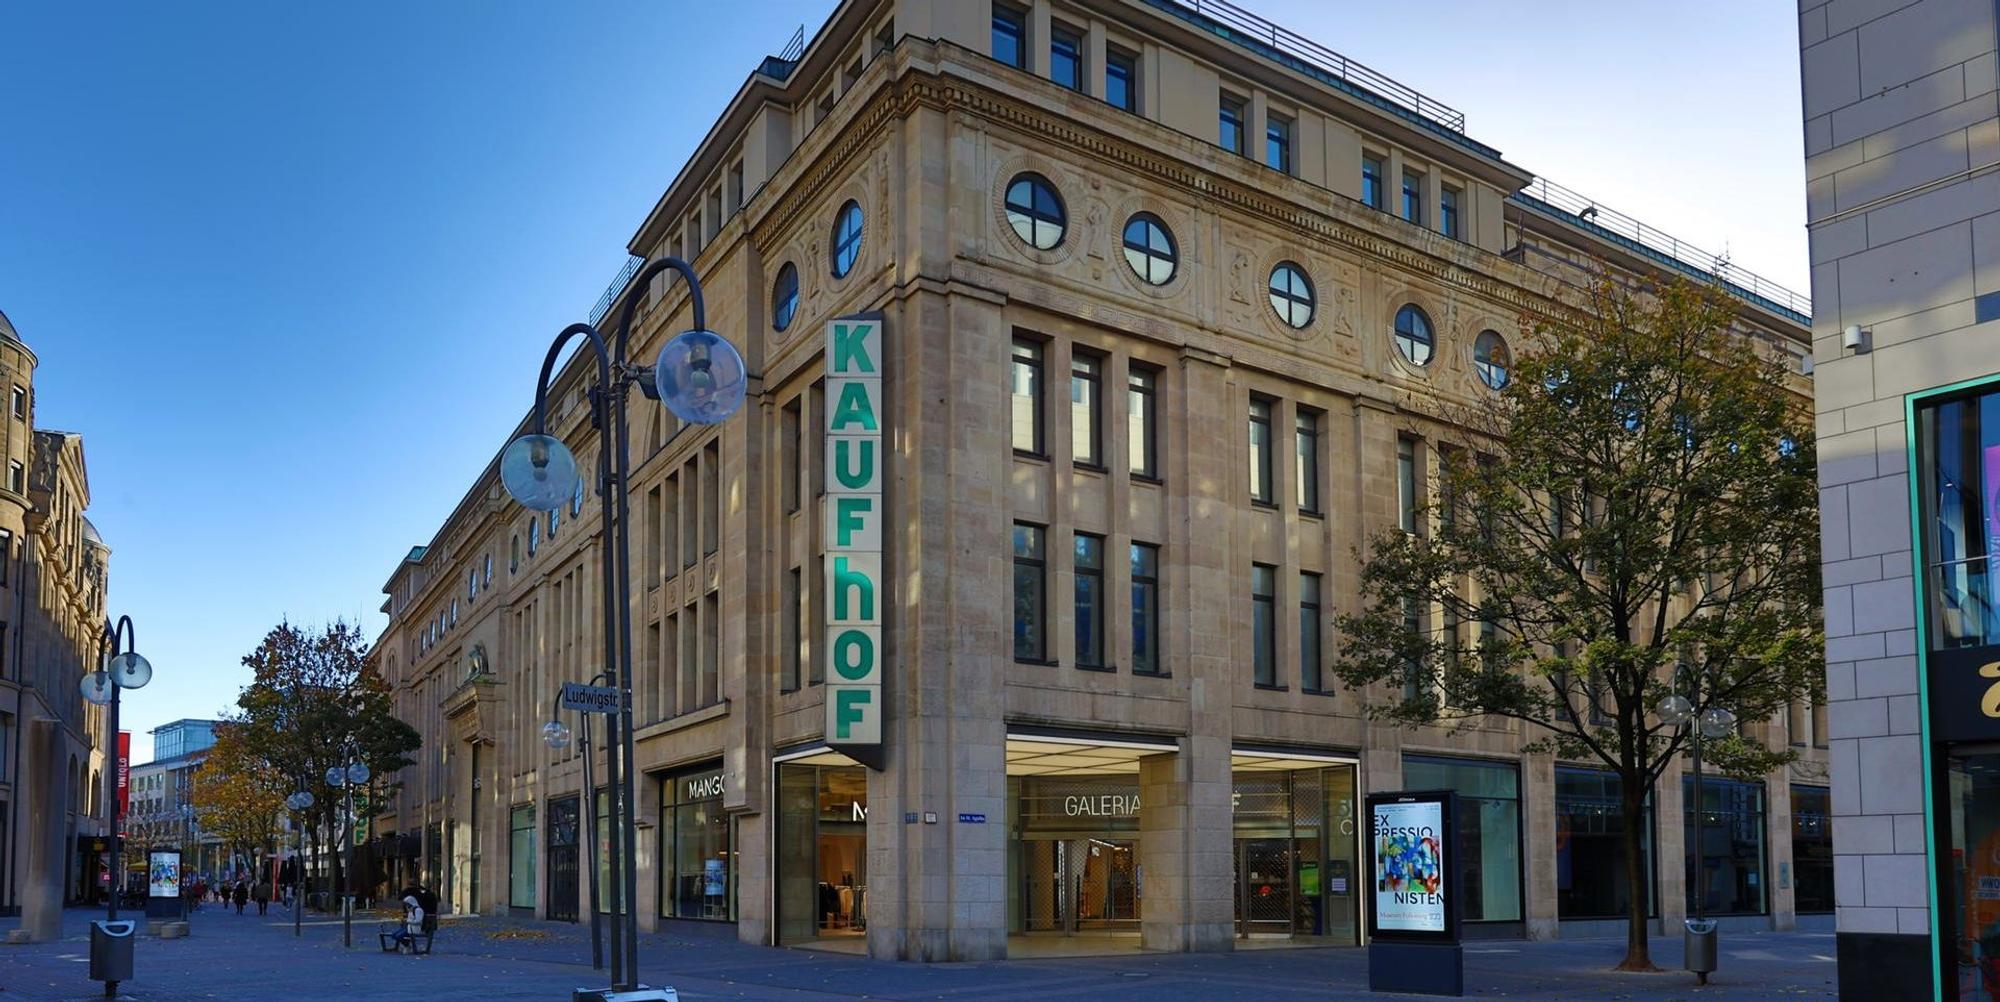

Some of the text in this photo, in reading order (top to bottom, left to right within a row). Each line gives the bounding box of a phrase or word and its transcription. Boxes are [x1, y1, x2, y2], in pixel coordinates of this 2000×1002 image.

[565, 686, 618, 709] Ludwigstr.
[1065, 795, 1141, 816] GALERIA
[1394, 892, 1444, 905] NISTEN
